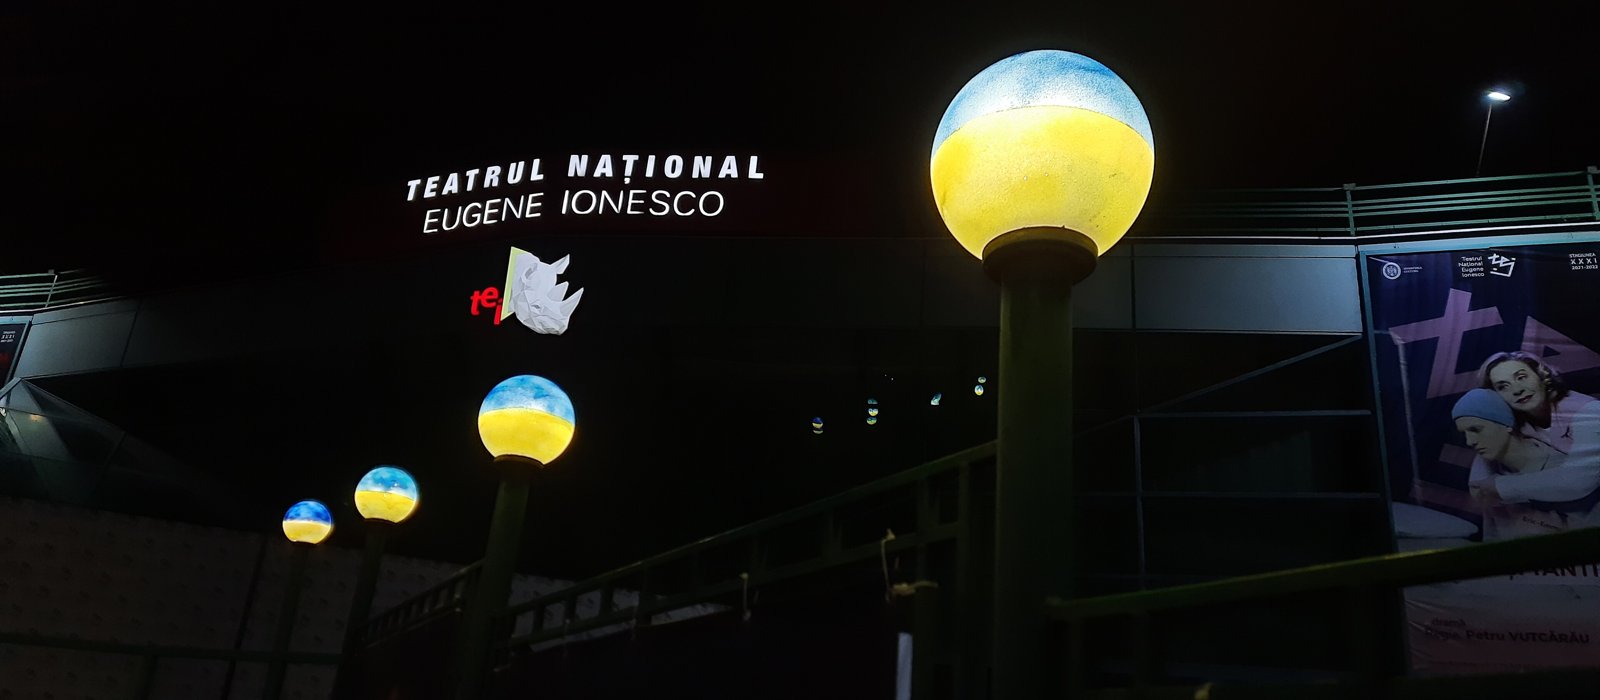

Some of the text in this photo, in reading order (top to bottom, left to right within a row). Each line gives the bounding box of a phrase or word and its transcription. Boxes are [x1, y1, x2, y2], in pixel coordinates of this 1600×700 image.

[406, 154, 765, 201] TEATRUL NAȚIONAL
[422, 189, 725, 233] EUGENE IONESCO
[1466, 629, 1505, 641] Petru
[1508, 631, 1590, 644] VUTCĂRĂU
